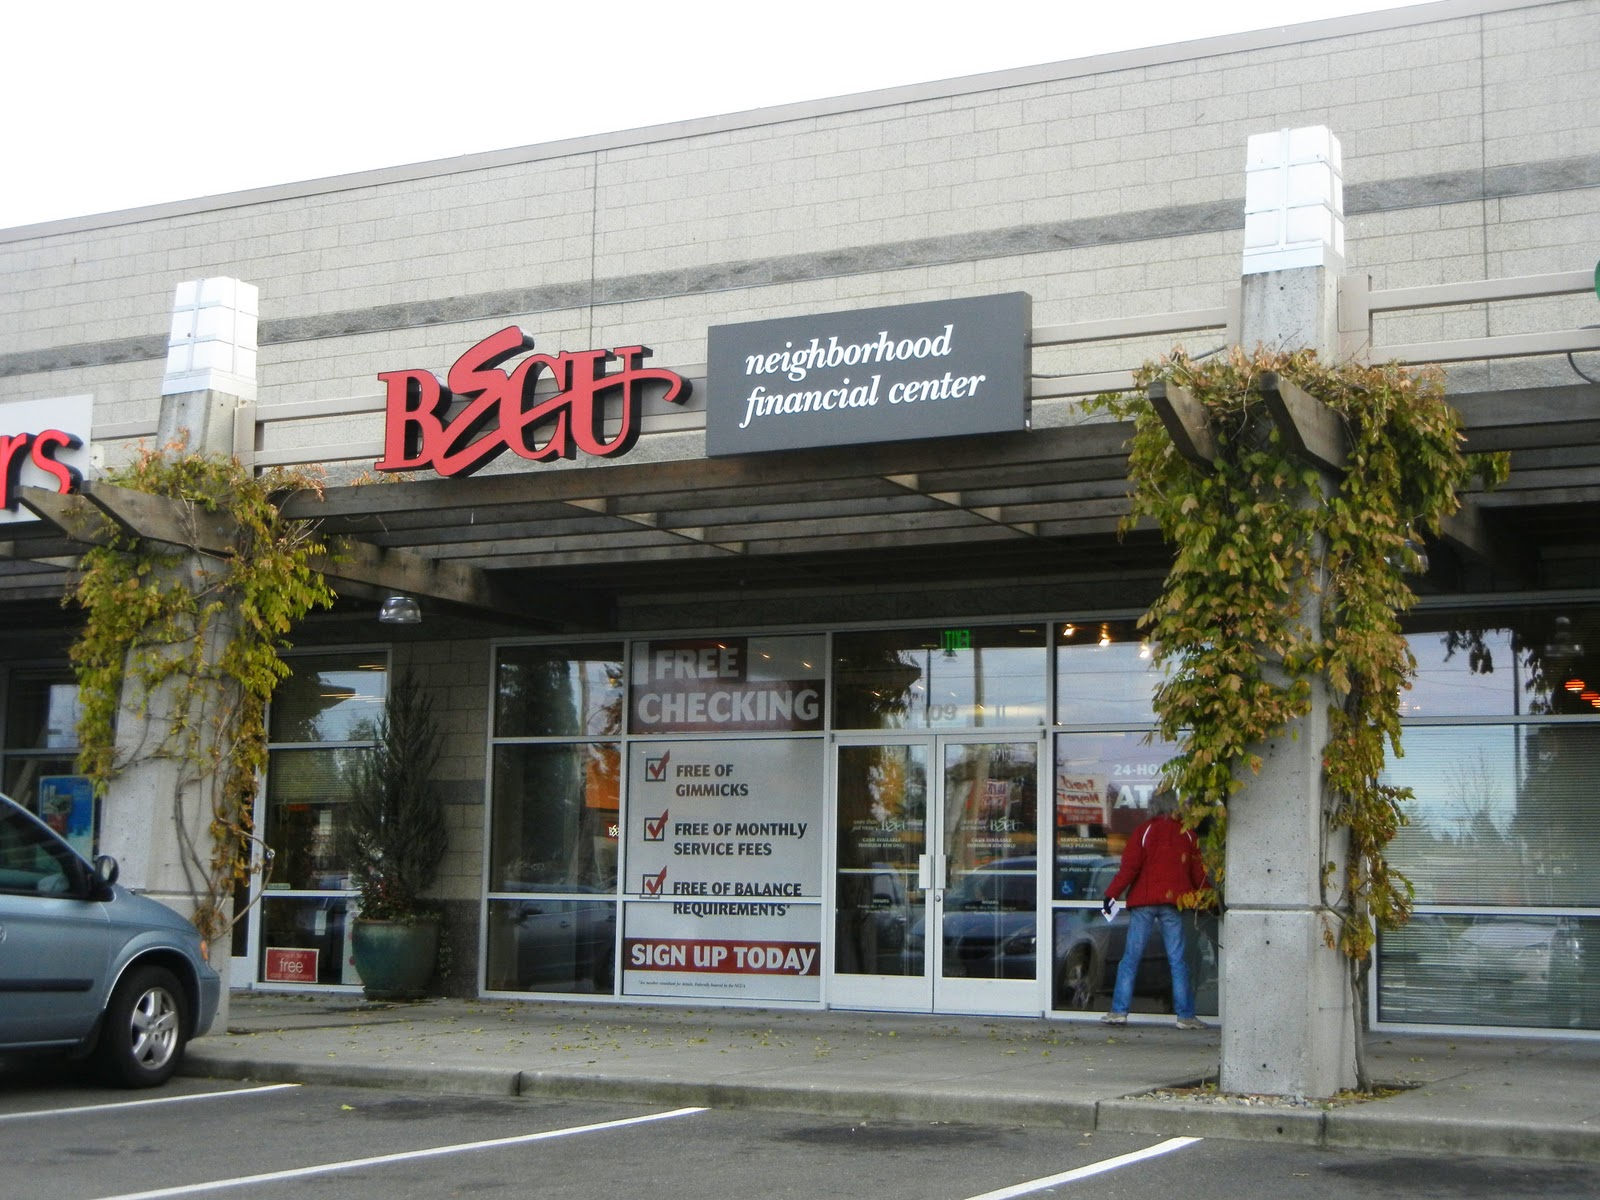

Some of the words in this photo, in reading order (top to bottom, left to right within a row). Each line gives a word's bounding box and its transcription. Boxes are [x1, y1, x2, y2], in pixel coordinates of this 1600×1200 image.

[744, 324, 954, 382] neighborhood
[374, 325, 690, 477] BECU
[738, 375, 881, 429] financial
[888, 372, 986, 405] center
[655, 647, 740, 680] FREE
[638, 689, 819, 724] CHECKING
[676, 764, 711, 777] FREE
[714, 764, 734, 777] OF
[675, 783, 749, 797] GIMMICKS
[674, 823, 709, 836] FREE
[713, 823, 732, 836] OF
[735, 823, 808, 839] MONTHLY
[673, 842, 734, 856] SERVICE
[738, 842, 772, 856] FEES
[673, 882, 708, 895] FREE
[711, 882, 730, 895] OF
[735, 882, 802, 897] BALANCE
[280, 957, 304, 973] free
[631, 943, 686, 967] SIGN
[693, 946, 728, 968] UP
[734, 947, 816, 975] TODAY
